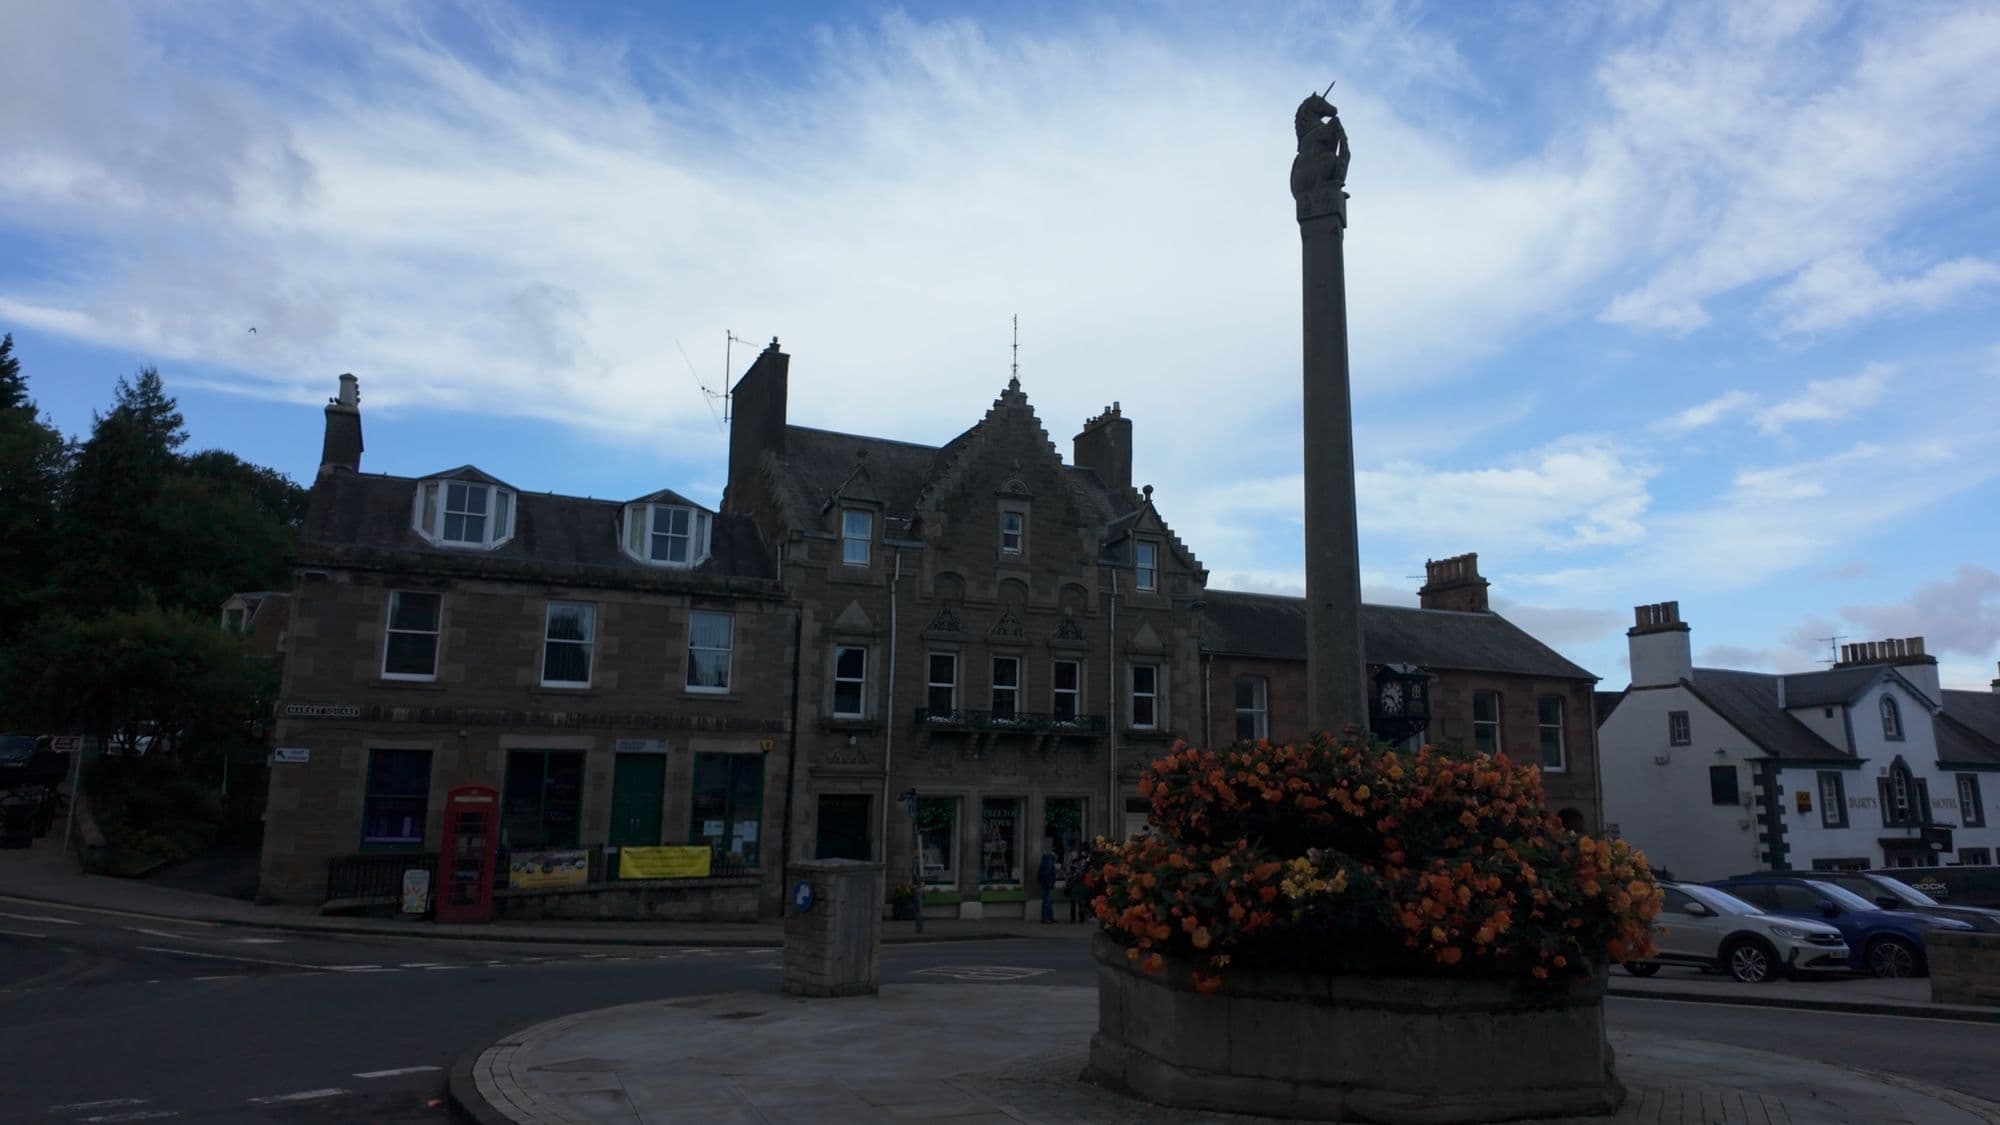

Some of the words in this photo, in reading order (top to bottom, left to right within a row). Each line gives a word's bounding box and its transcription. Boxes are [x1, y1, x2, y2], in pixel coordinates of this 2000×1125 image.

[287, 705, 323, 714] MARKET
[325, 706, 360, 715] SQUARE
[1932, 798, 1958, 809] HOTEL
